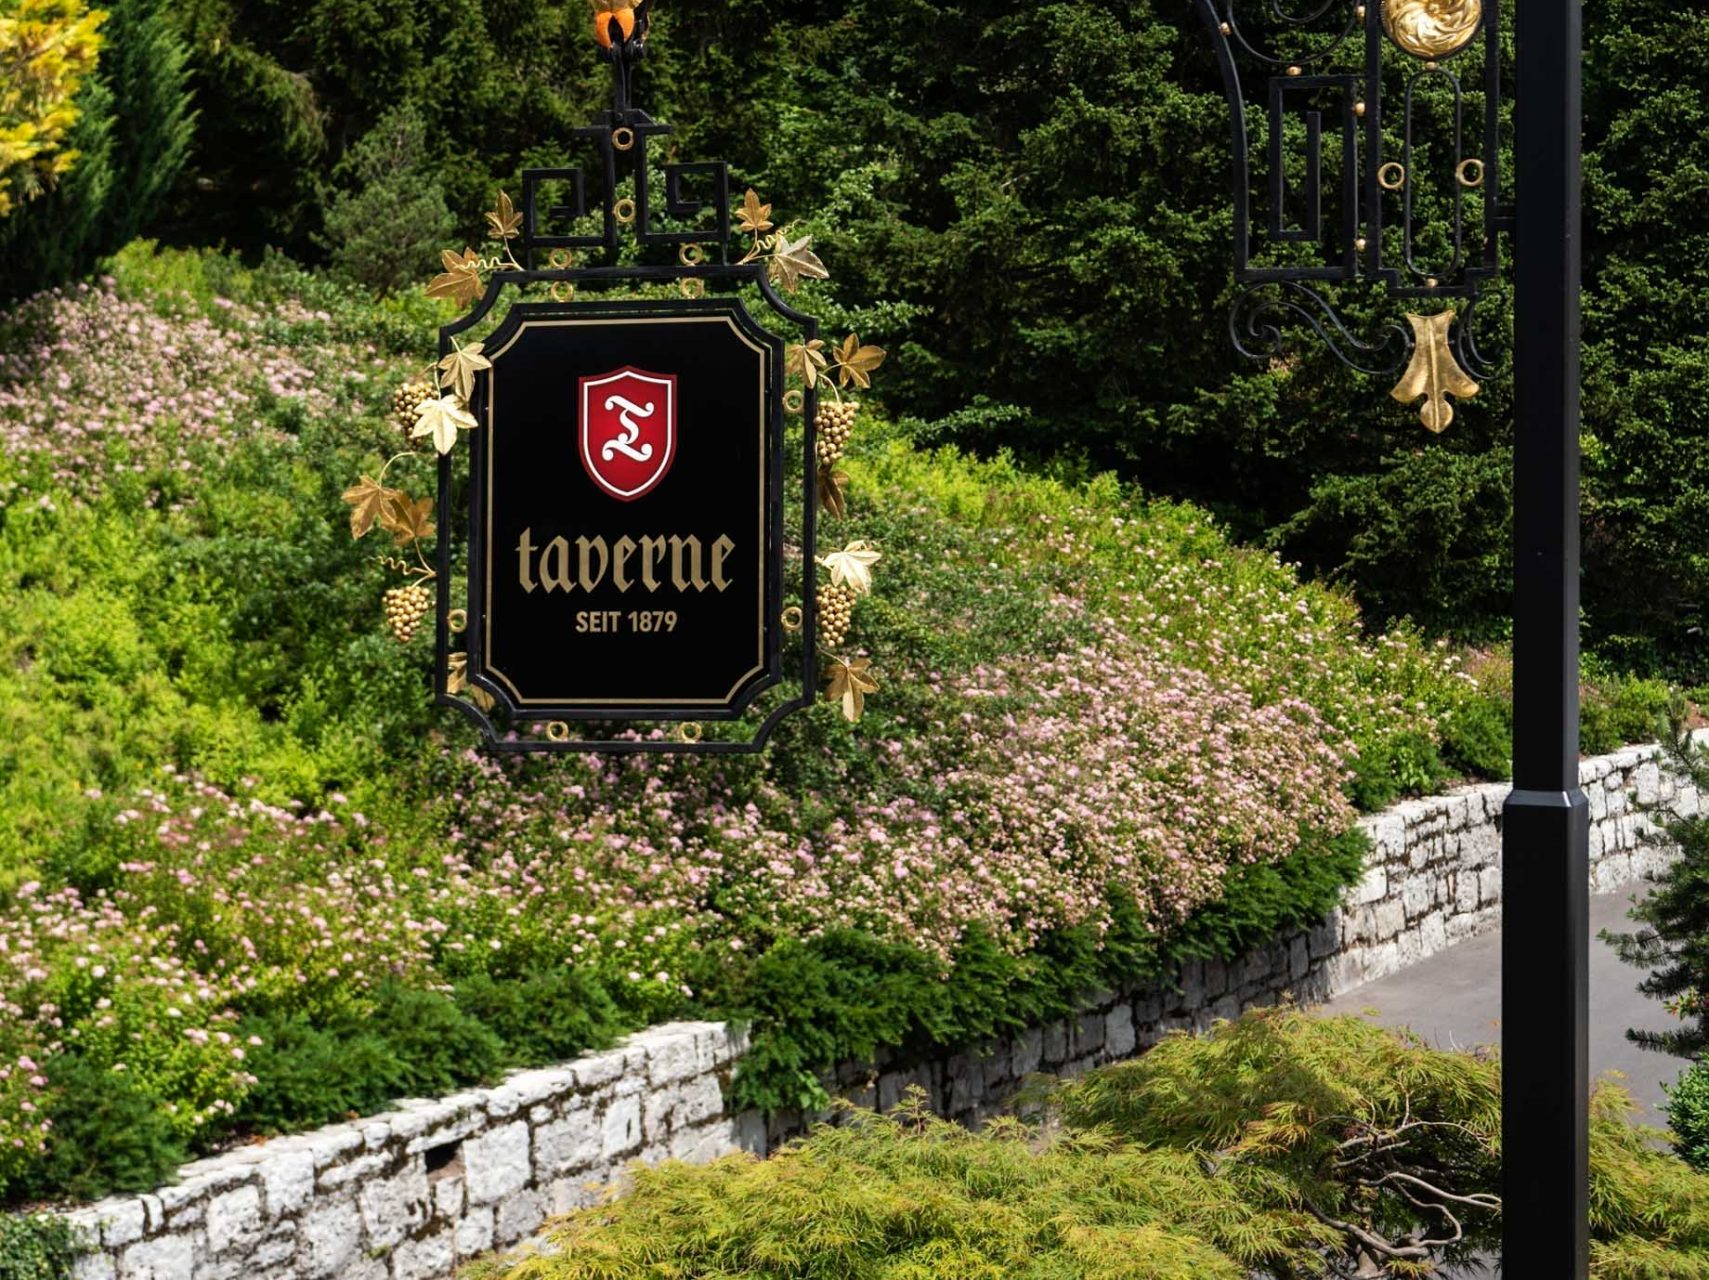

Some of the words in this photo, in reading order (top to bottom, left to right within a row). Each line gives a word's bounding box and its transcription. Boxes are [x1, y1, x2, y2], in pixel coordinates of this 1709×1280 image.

[514, 526, 736, 594] taverne
[575, 610, 622, 632] SEIT
[627, 610, 678, 632] 1879
